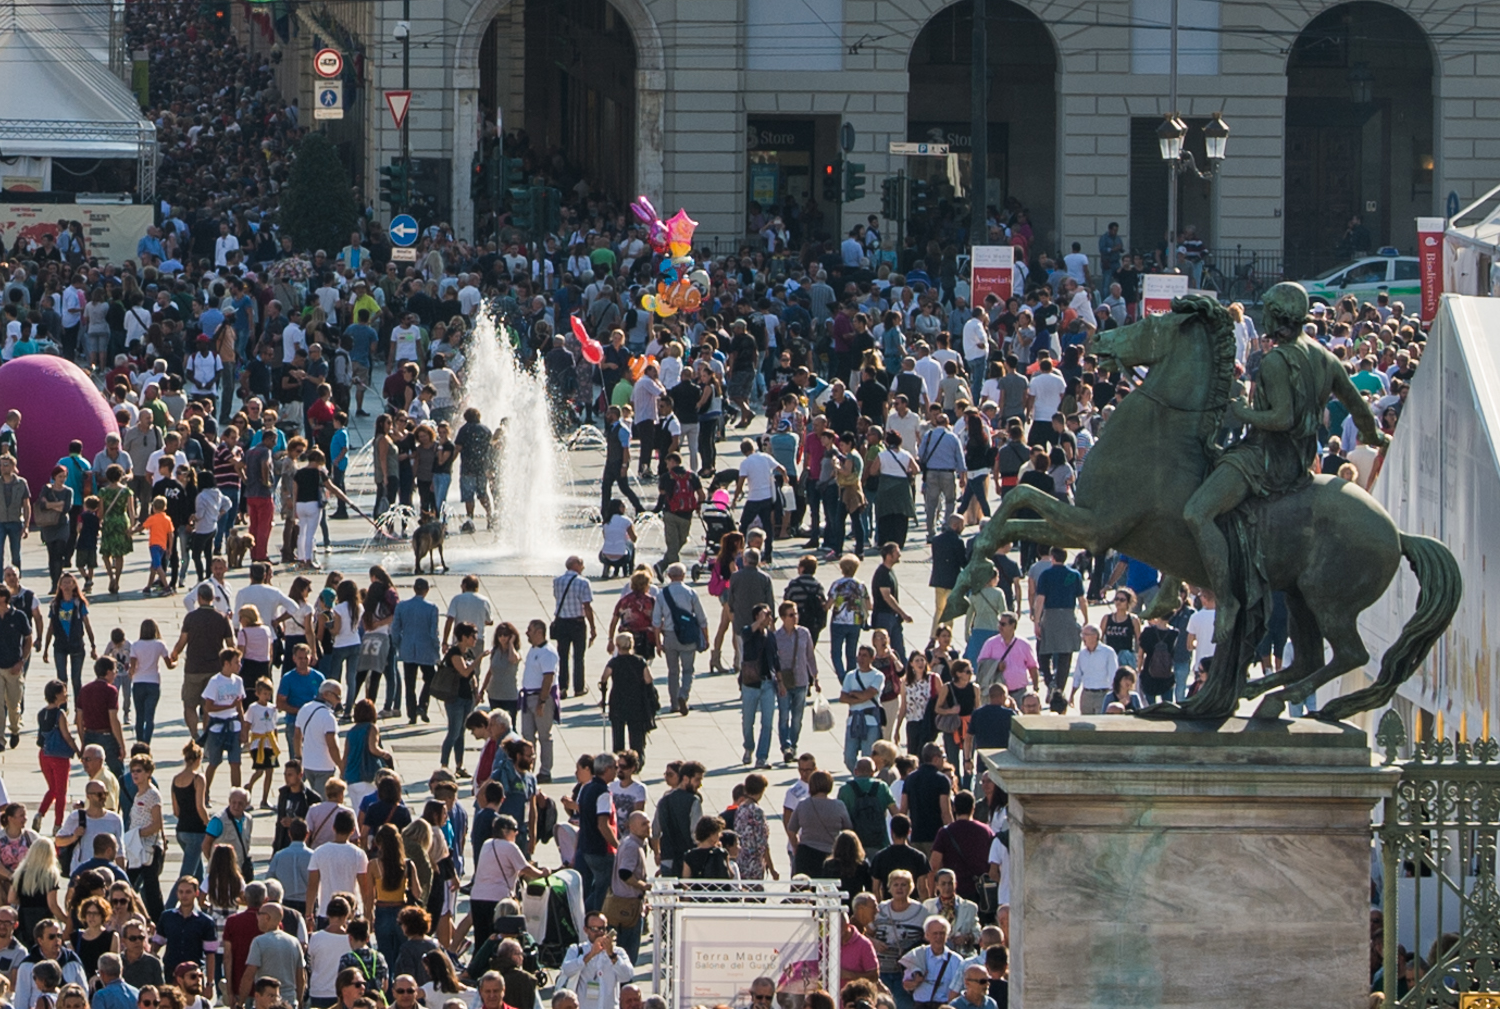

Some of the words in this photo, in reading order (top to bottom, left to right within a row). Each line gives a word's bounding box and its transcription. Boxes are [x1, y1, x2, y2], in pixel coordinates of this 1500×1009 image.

[760, 131, 795, 145] Store
[947, 132, 972, 147] Stor
[1425, 252, 1436, 312] Biodiversity
[363, 639, 382, 656] 73
[695, 952, 729, 960] Terra
[736, 952, 777, 960] Madre
[695, 961, 726, 970] Salone
[731, 961, 744, 970] del
[749, 961, 776, 970] Gusto
